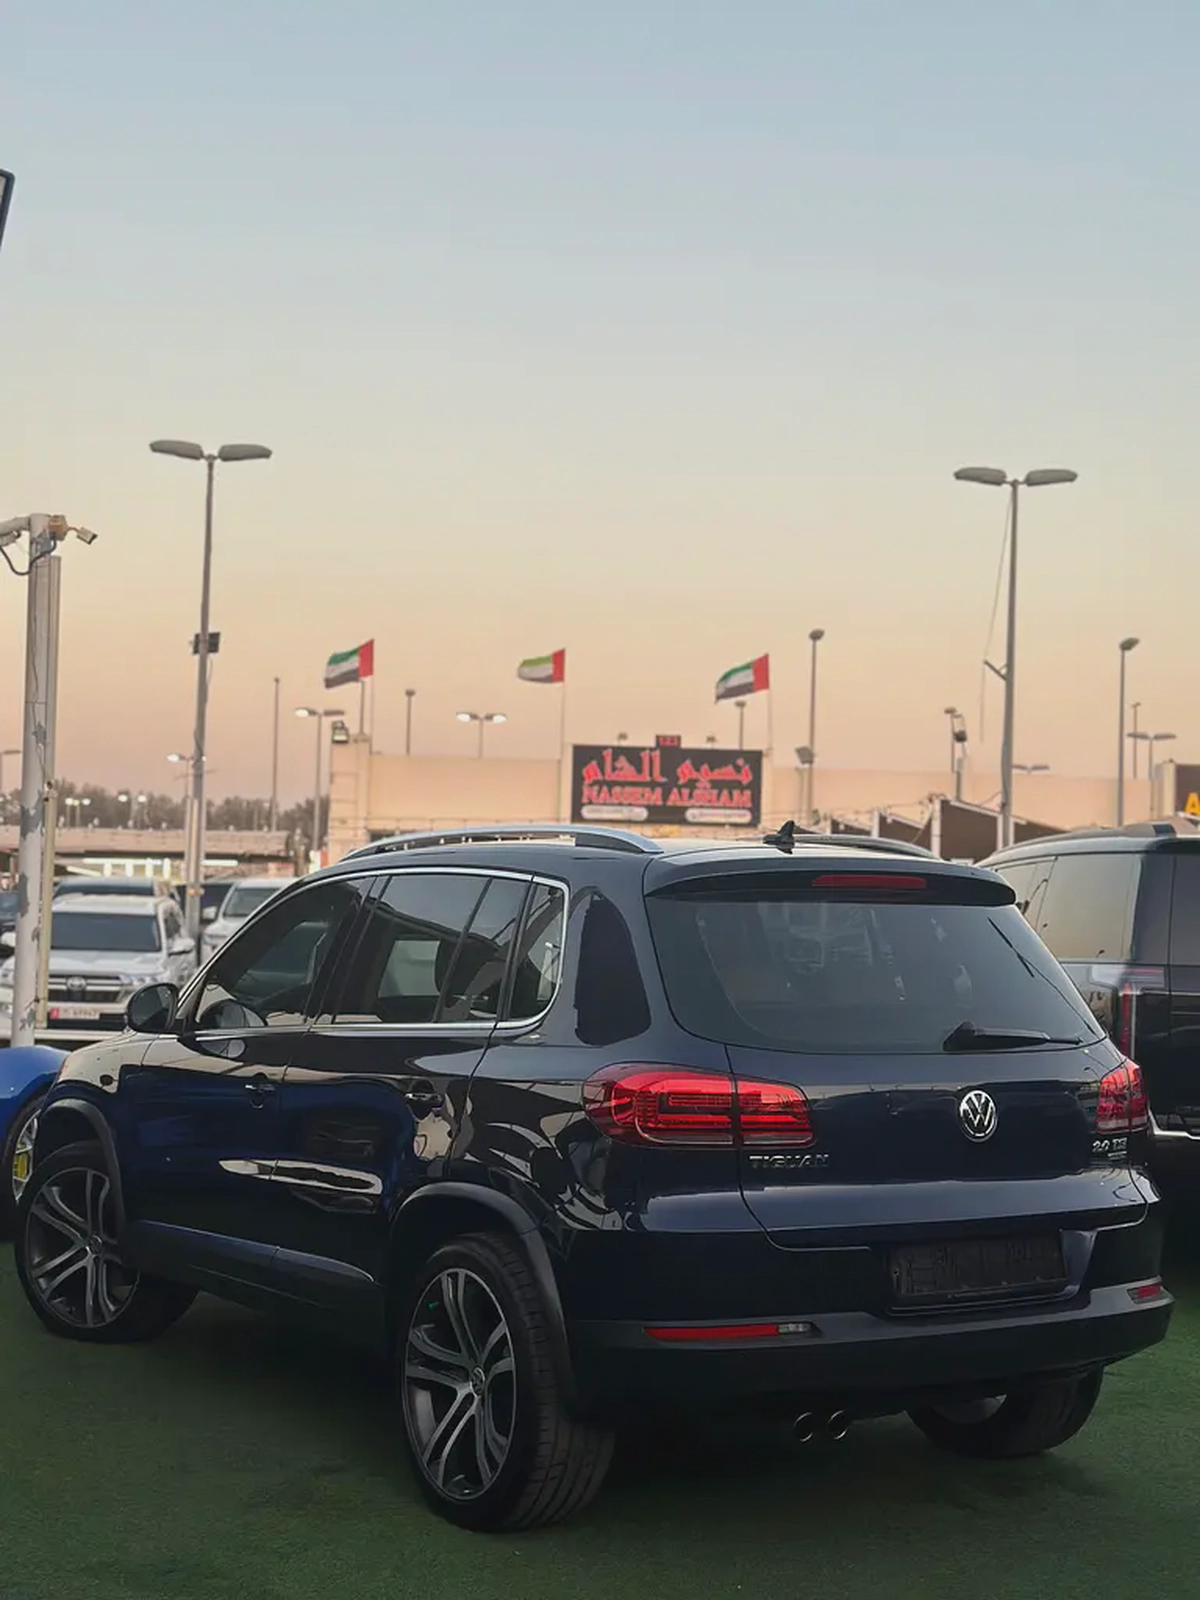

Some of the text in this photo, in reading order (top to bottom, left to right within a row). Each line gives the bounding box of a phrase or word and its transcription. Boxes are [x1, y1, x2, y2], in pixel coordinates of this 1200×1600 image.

[582, 749, 752, 789] نسيم الشام
[666, 787, 752, 807] ALSHAM
[749, 1153, 829, 1168] TIGUAN
